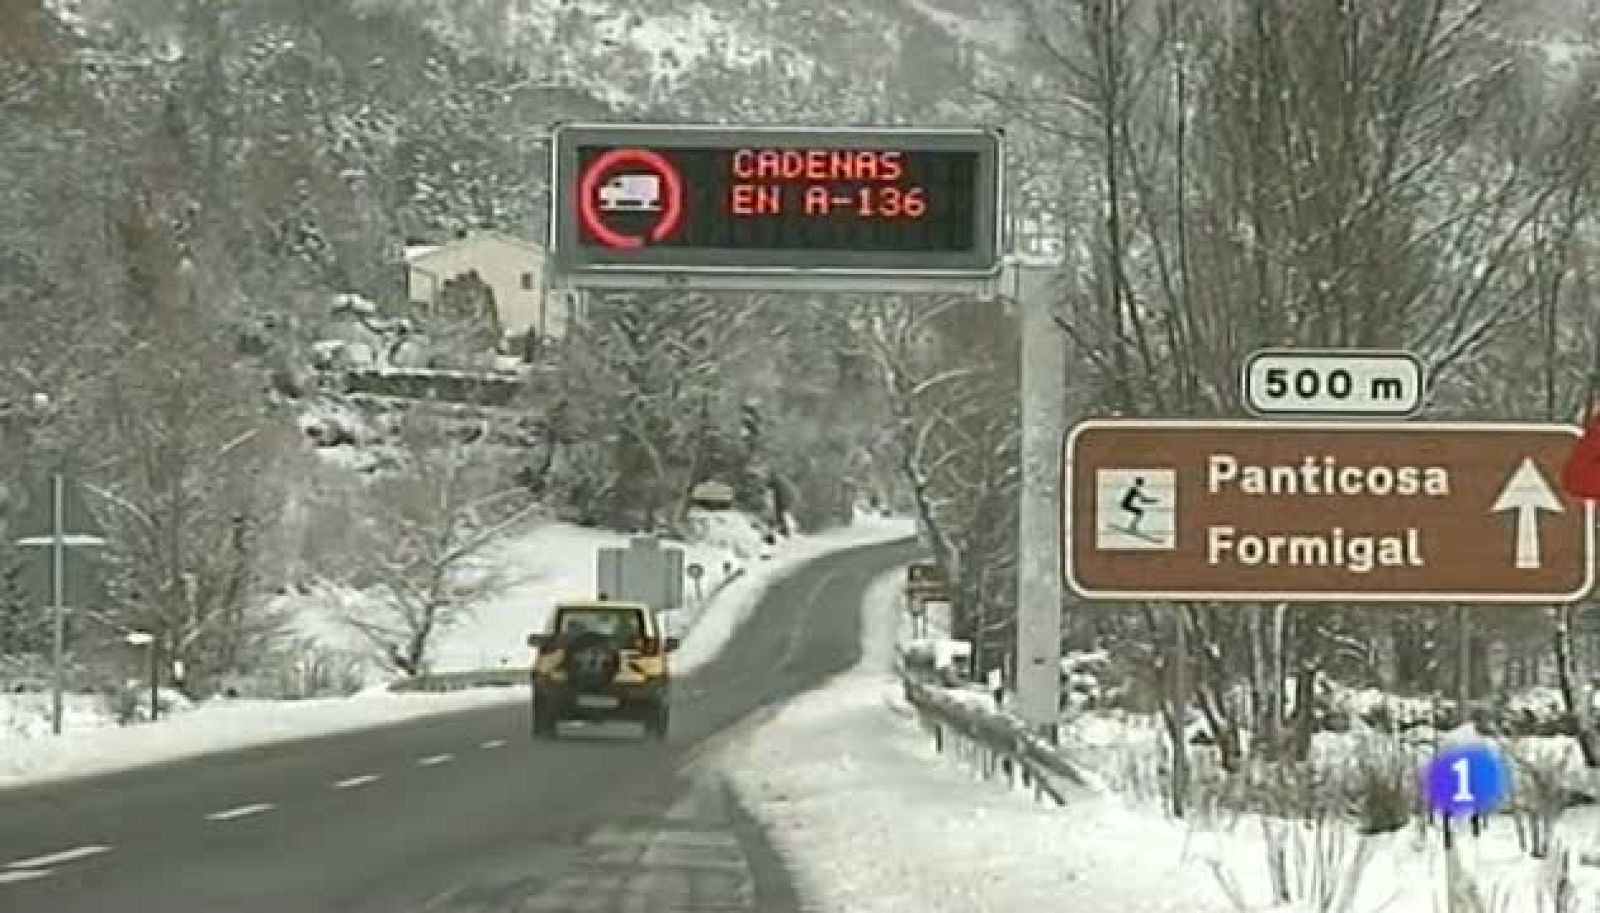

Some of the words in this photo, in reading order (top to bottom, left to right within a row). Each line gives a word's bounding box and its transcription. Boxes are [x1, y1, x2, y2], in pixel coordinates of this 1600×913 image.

[733, 149, 902, 180] CADENAS
[732, 185, 780, 215] EN
[805, 187, 926, 217] A-136
[1265, 369, 1353, 398] 500
[1371, 376, 1403, 399] m
[1208, 455, 1450, 495] Panticosa
[1208, 526, 1424, 572] Formigal
